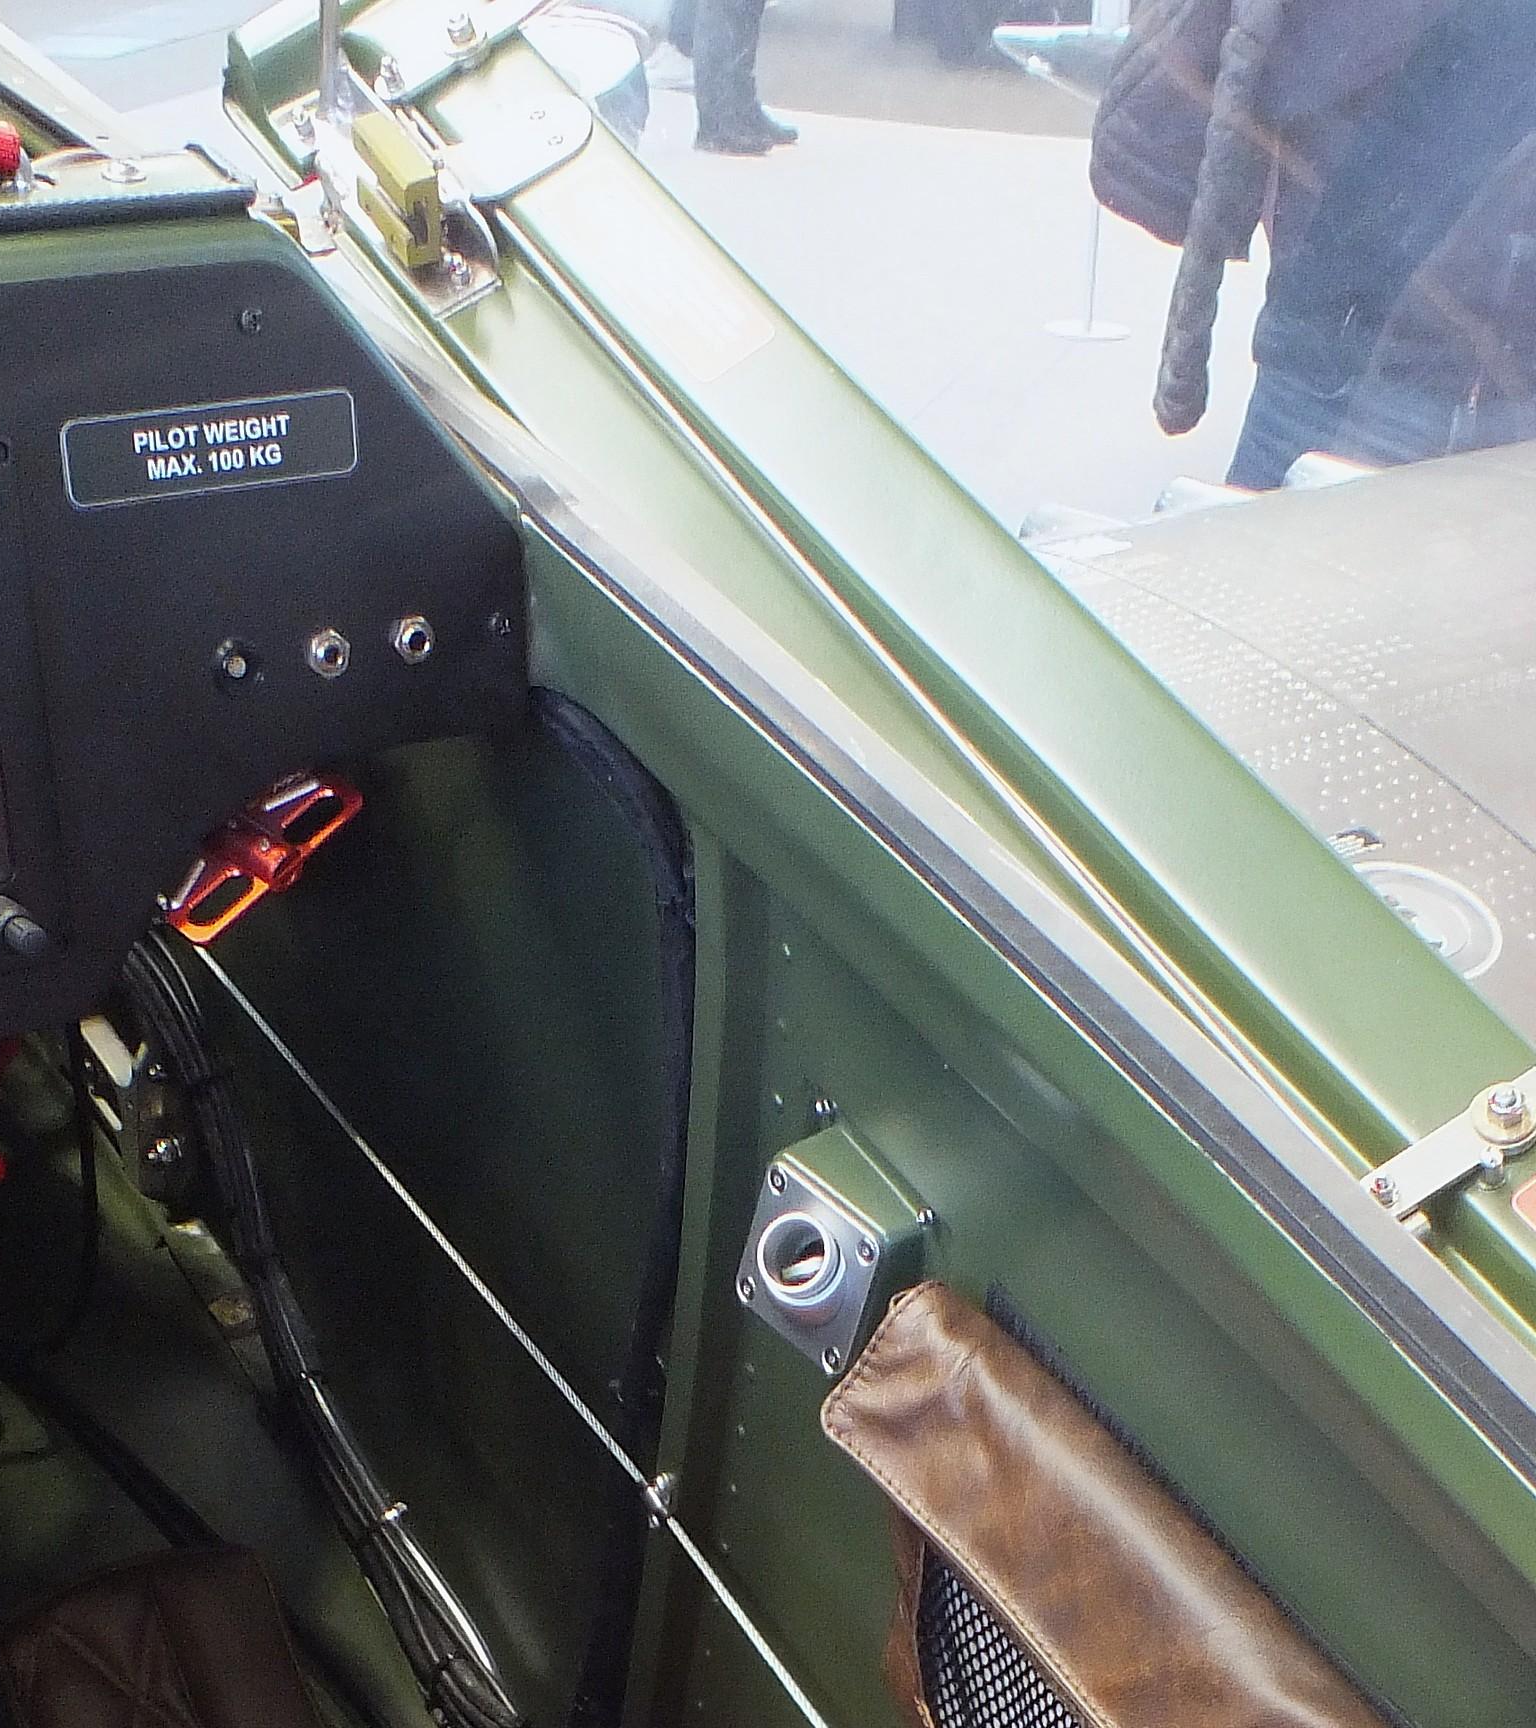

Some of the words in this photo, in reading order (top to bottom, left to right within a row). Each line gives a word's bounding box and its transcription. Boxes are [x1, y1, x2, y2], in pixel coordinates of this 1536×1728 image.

[133, 425, 199, 454] PILOT
[202, 414, 290, 445] WEIGHT
[147, 453, 203, 481] MAX.
[208, 448, 245, 472] 100
[249, 443, 282, 467] KG
